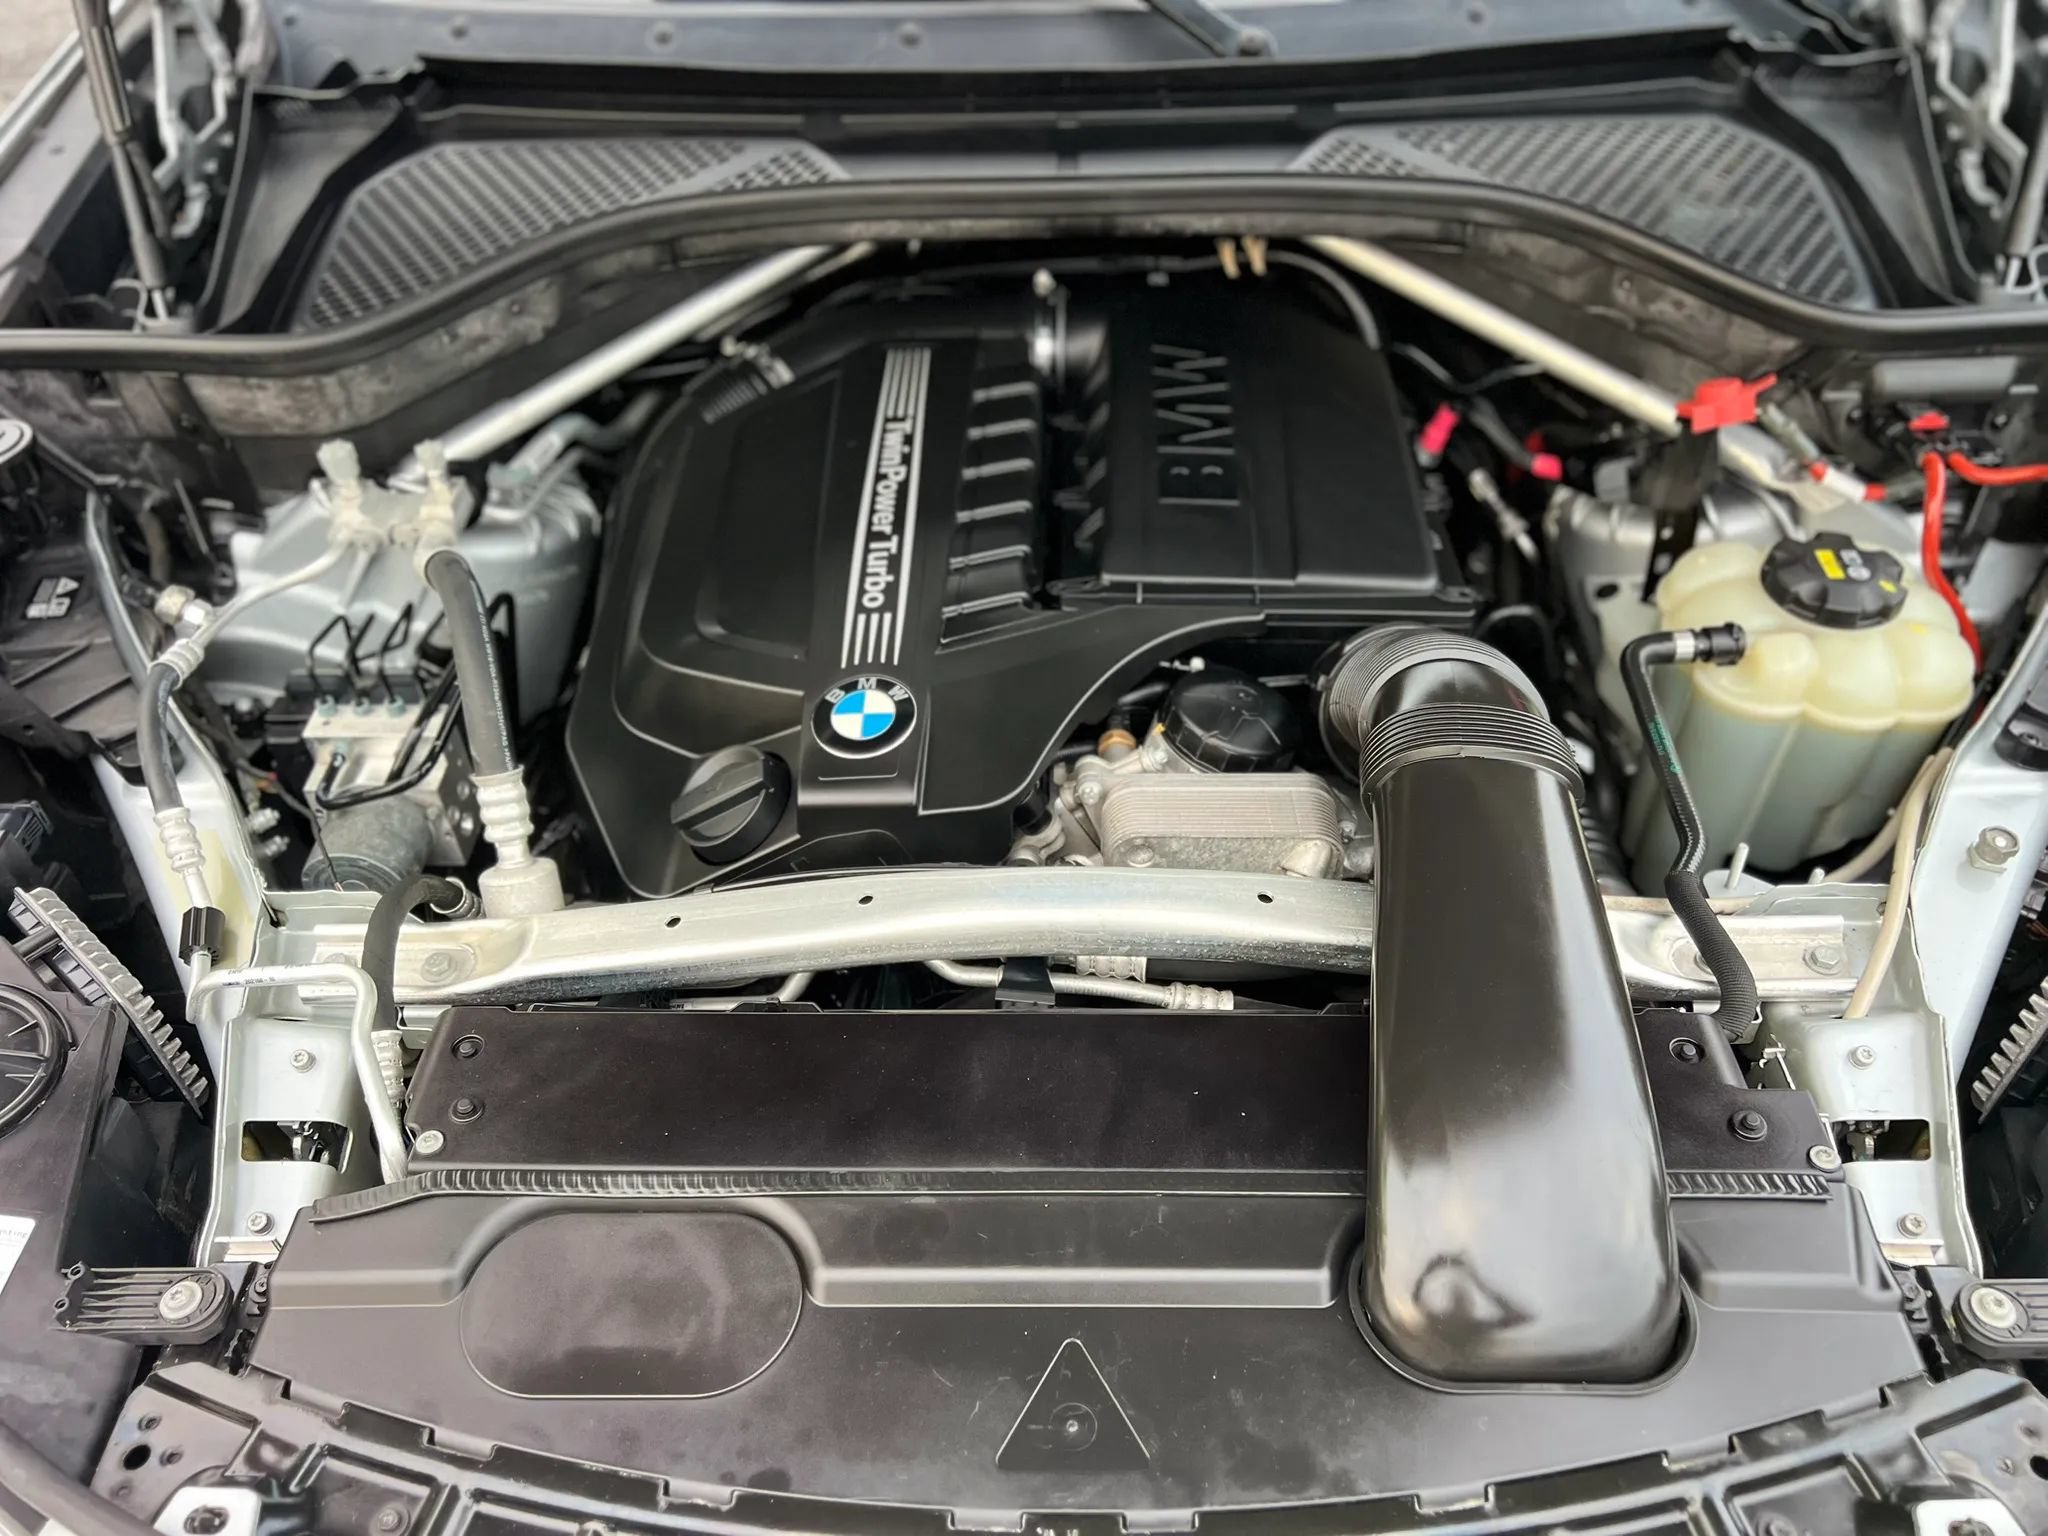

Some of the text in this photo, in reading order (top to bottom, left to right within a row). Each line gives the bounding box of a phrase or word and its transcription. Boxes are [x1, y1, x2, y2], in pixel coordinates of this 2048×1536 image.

[1149, 343, 1240, 506] BMW
[861, 418, 913, 609] TwinPower Turbo
[824, 676, 909, 704] BMW
